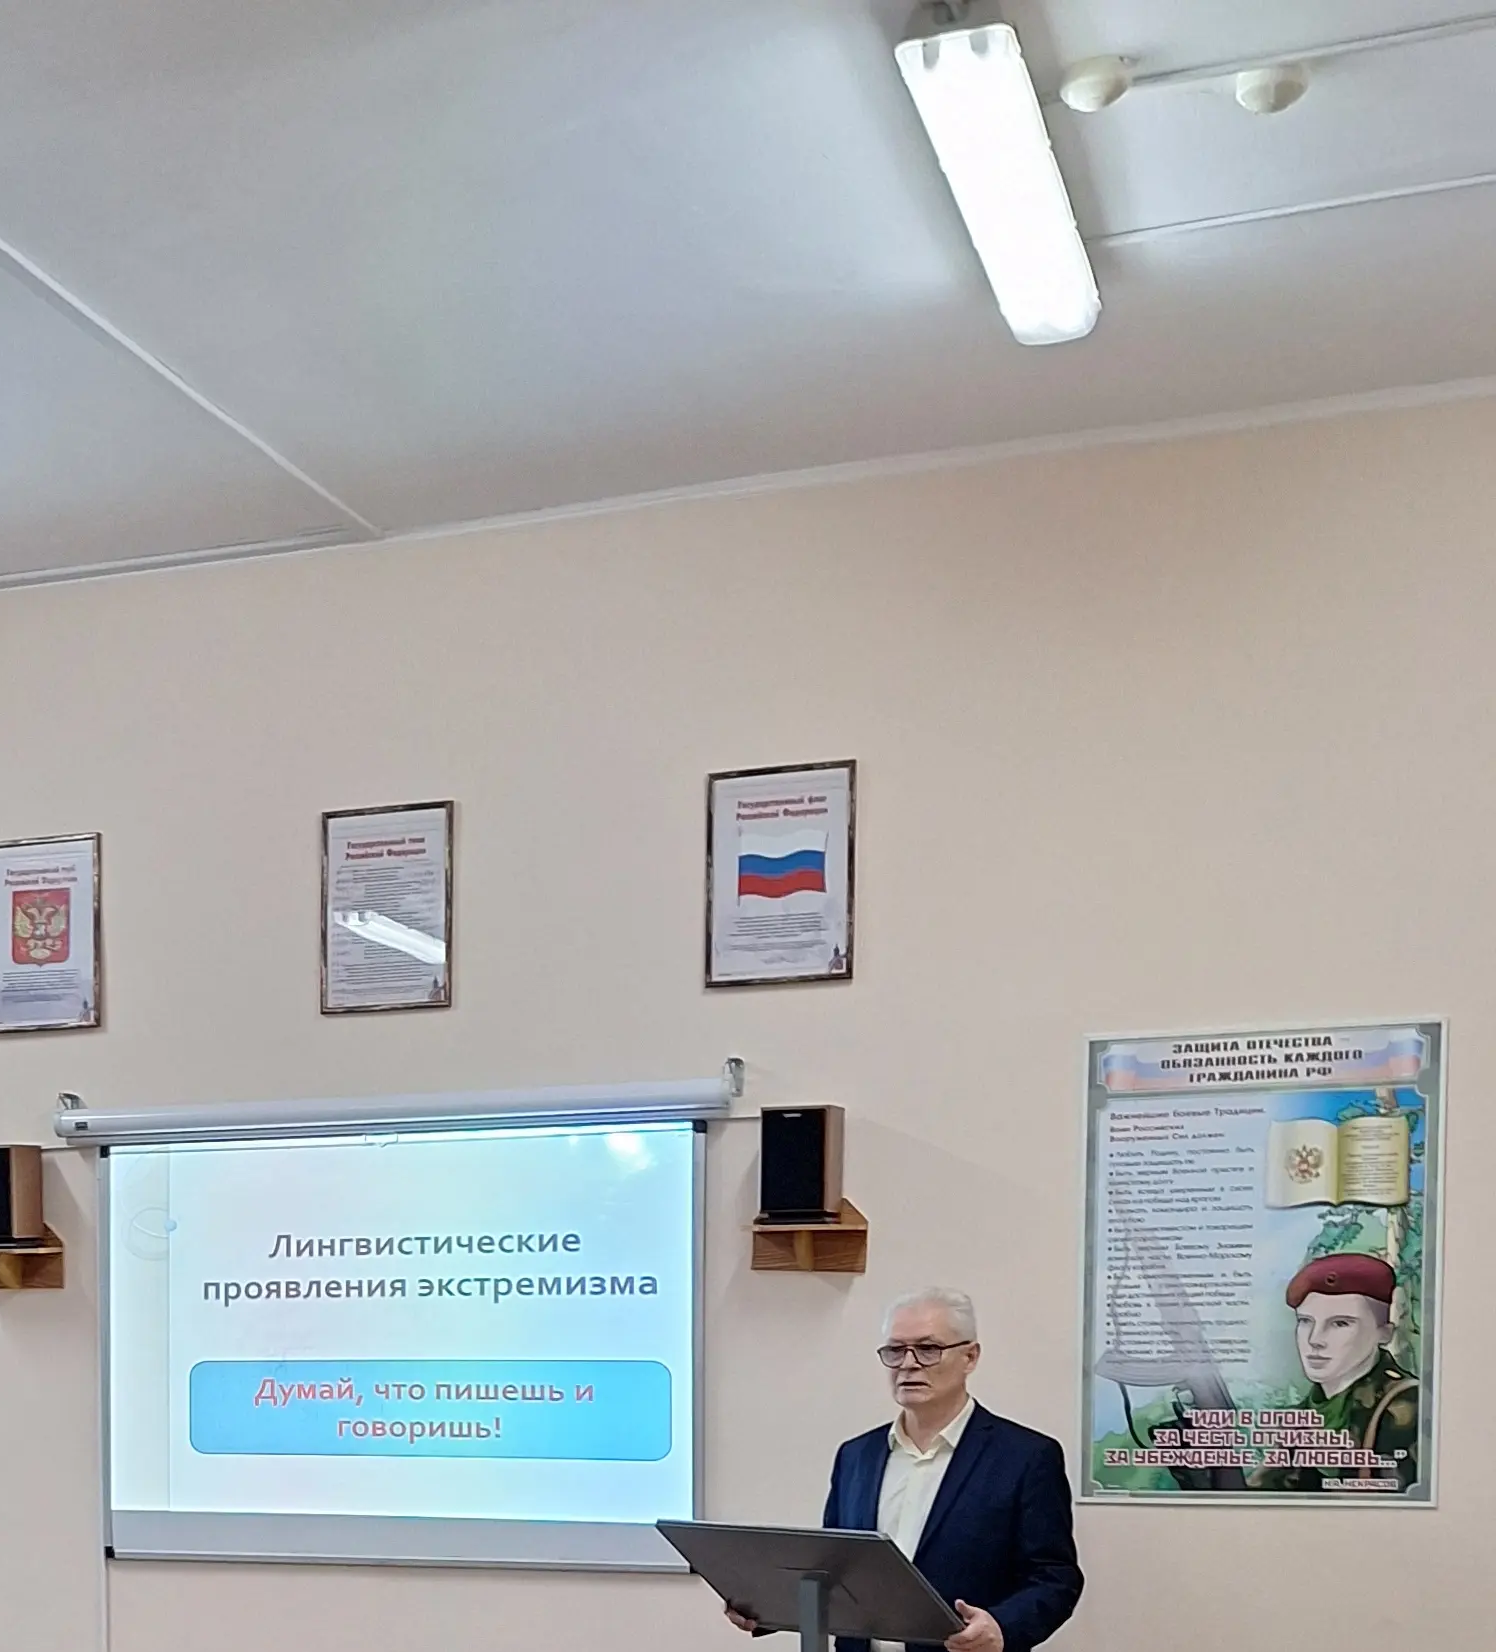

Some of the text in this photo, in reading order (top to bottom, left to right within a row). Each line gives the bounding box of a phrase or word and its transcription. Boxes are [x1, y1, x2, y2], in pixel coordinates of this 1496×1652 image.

[1172, 1036, 1332, 1054] ЗАЩИТА ОТЕЧЕСТВА
[1161, 1050, 1363, 1070] ОБЯЗАННОСТЬ КАЖДОГО
[1189, 1066, 1332, 1083] ГРАЖДАНИНА РФ
[268, 1232, 581, 1258] Лингвистические
[203, 1275, 658, 1307] проявления экстремизма
[254, 1377, 594, 1407] Думай, что пишешь и
[1240, 1412, 1252, 1426] В
[1259, 1411, 1323, 1427] ОГОНЬ
[337, 1417, 501, 1444] говоришь!
[1155, 1430, 1179, 1446] ЗА
[1184, 1430, 1245, 1446] ЧЕСТЬ
[1106, 1449, 1128, 1465] ЗА
[1265, 1449, 1289, 1465] ЗА
